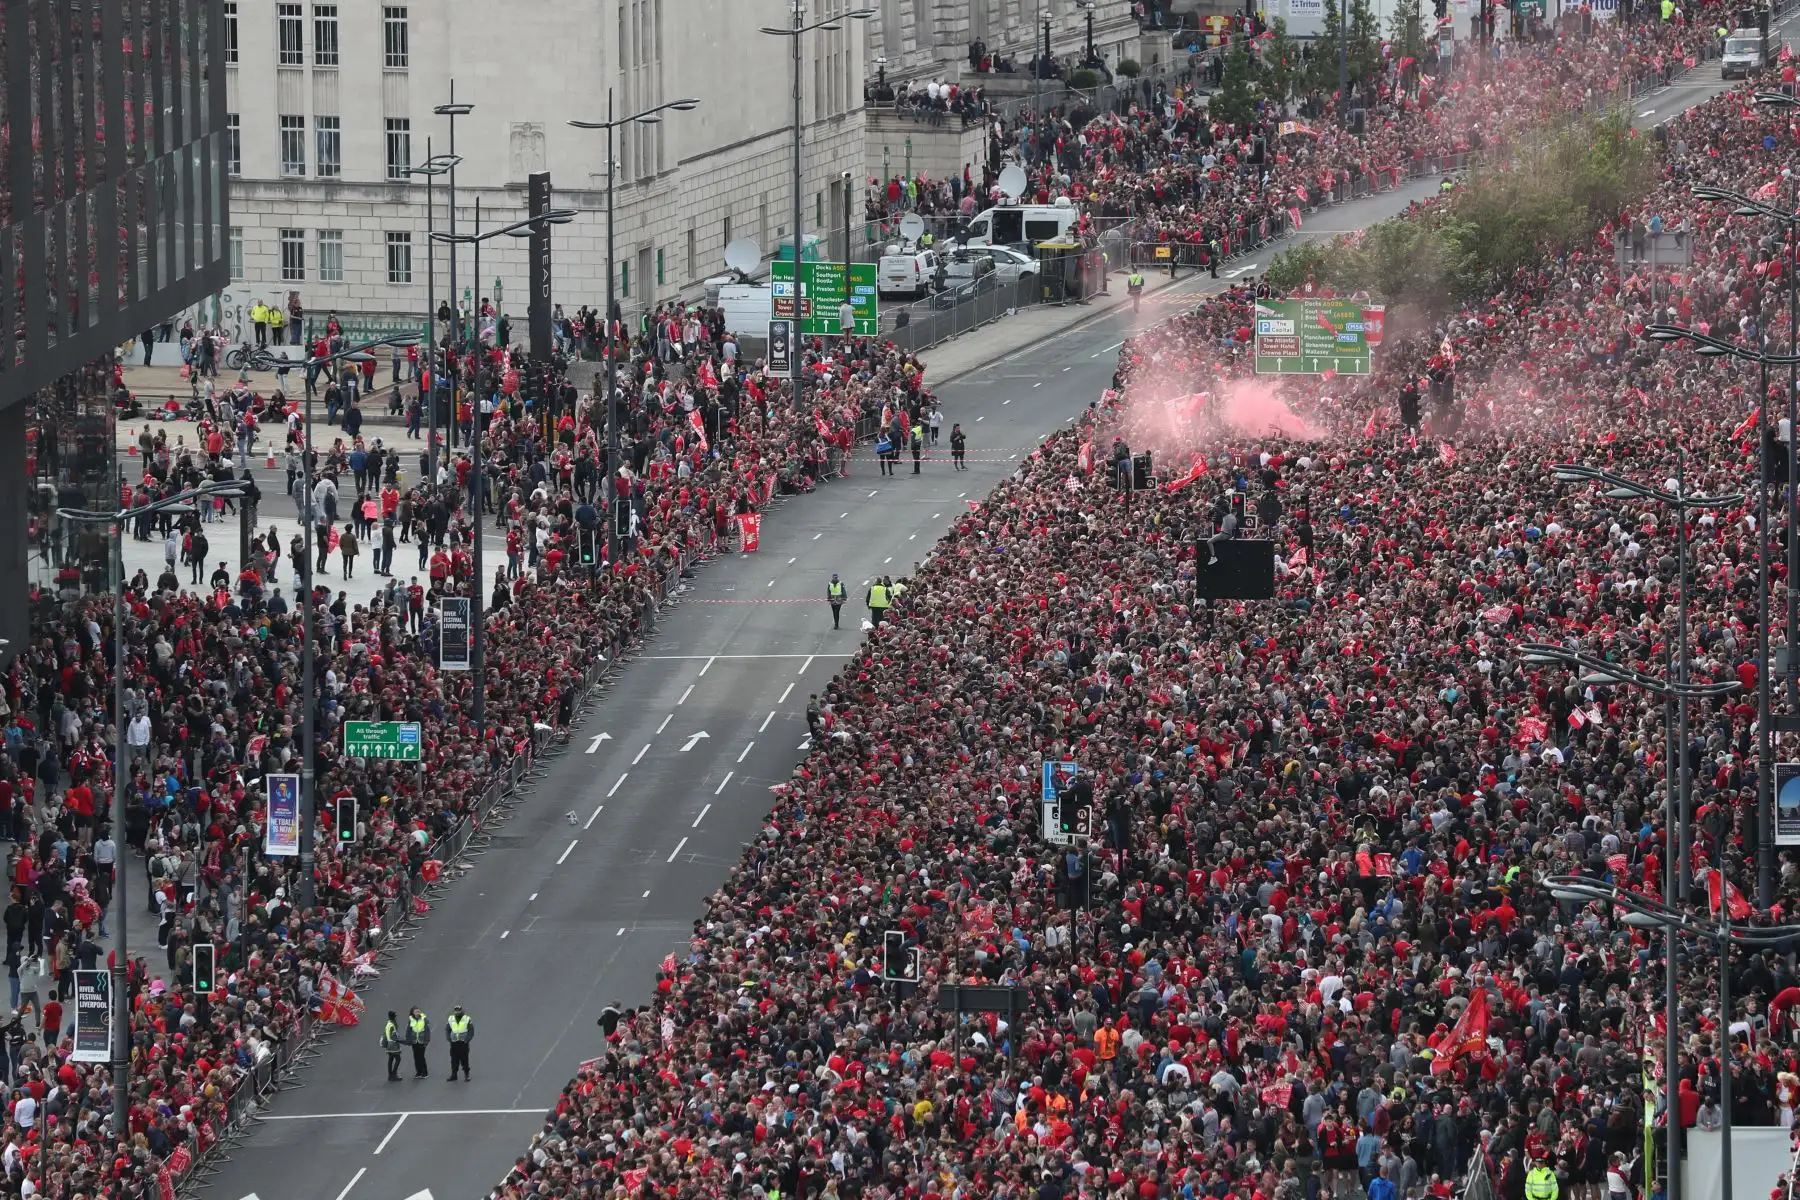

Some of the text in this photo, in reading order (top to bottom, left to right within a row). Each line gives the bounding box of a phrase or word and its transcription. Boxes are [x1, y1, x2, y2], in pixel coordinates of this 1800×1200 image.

[1300, 0, 1320, 8] Triton
[270, 818, 296, 826] NETBALL
[1195, 873, 1202, 884] 7
[1175, 964, 1181, 976] 4
[79, 985, 95, 993] RIVER
[79, 993, 102, 1001] FESTIVAL
[79, 1001, 108, 1009] LIVERPOOL
